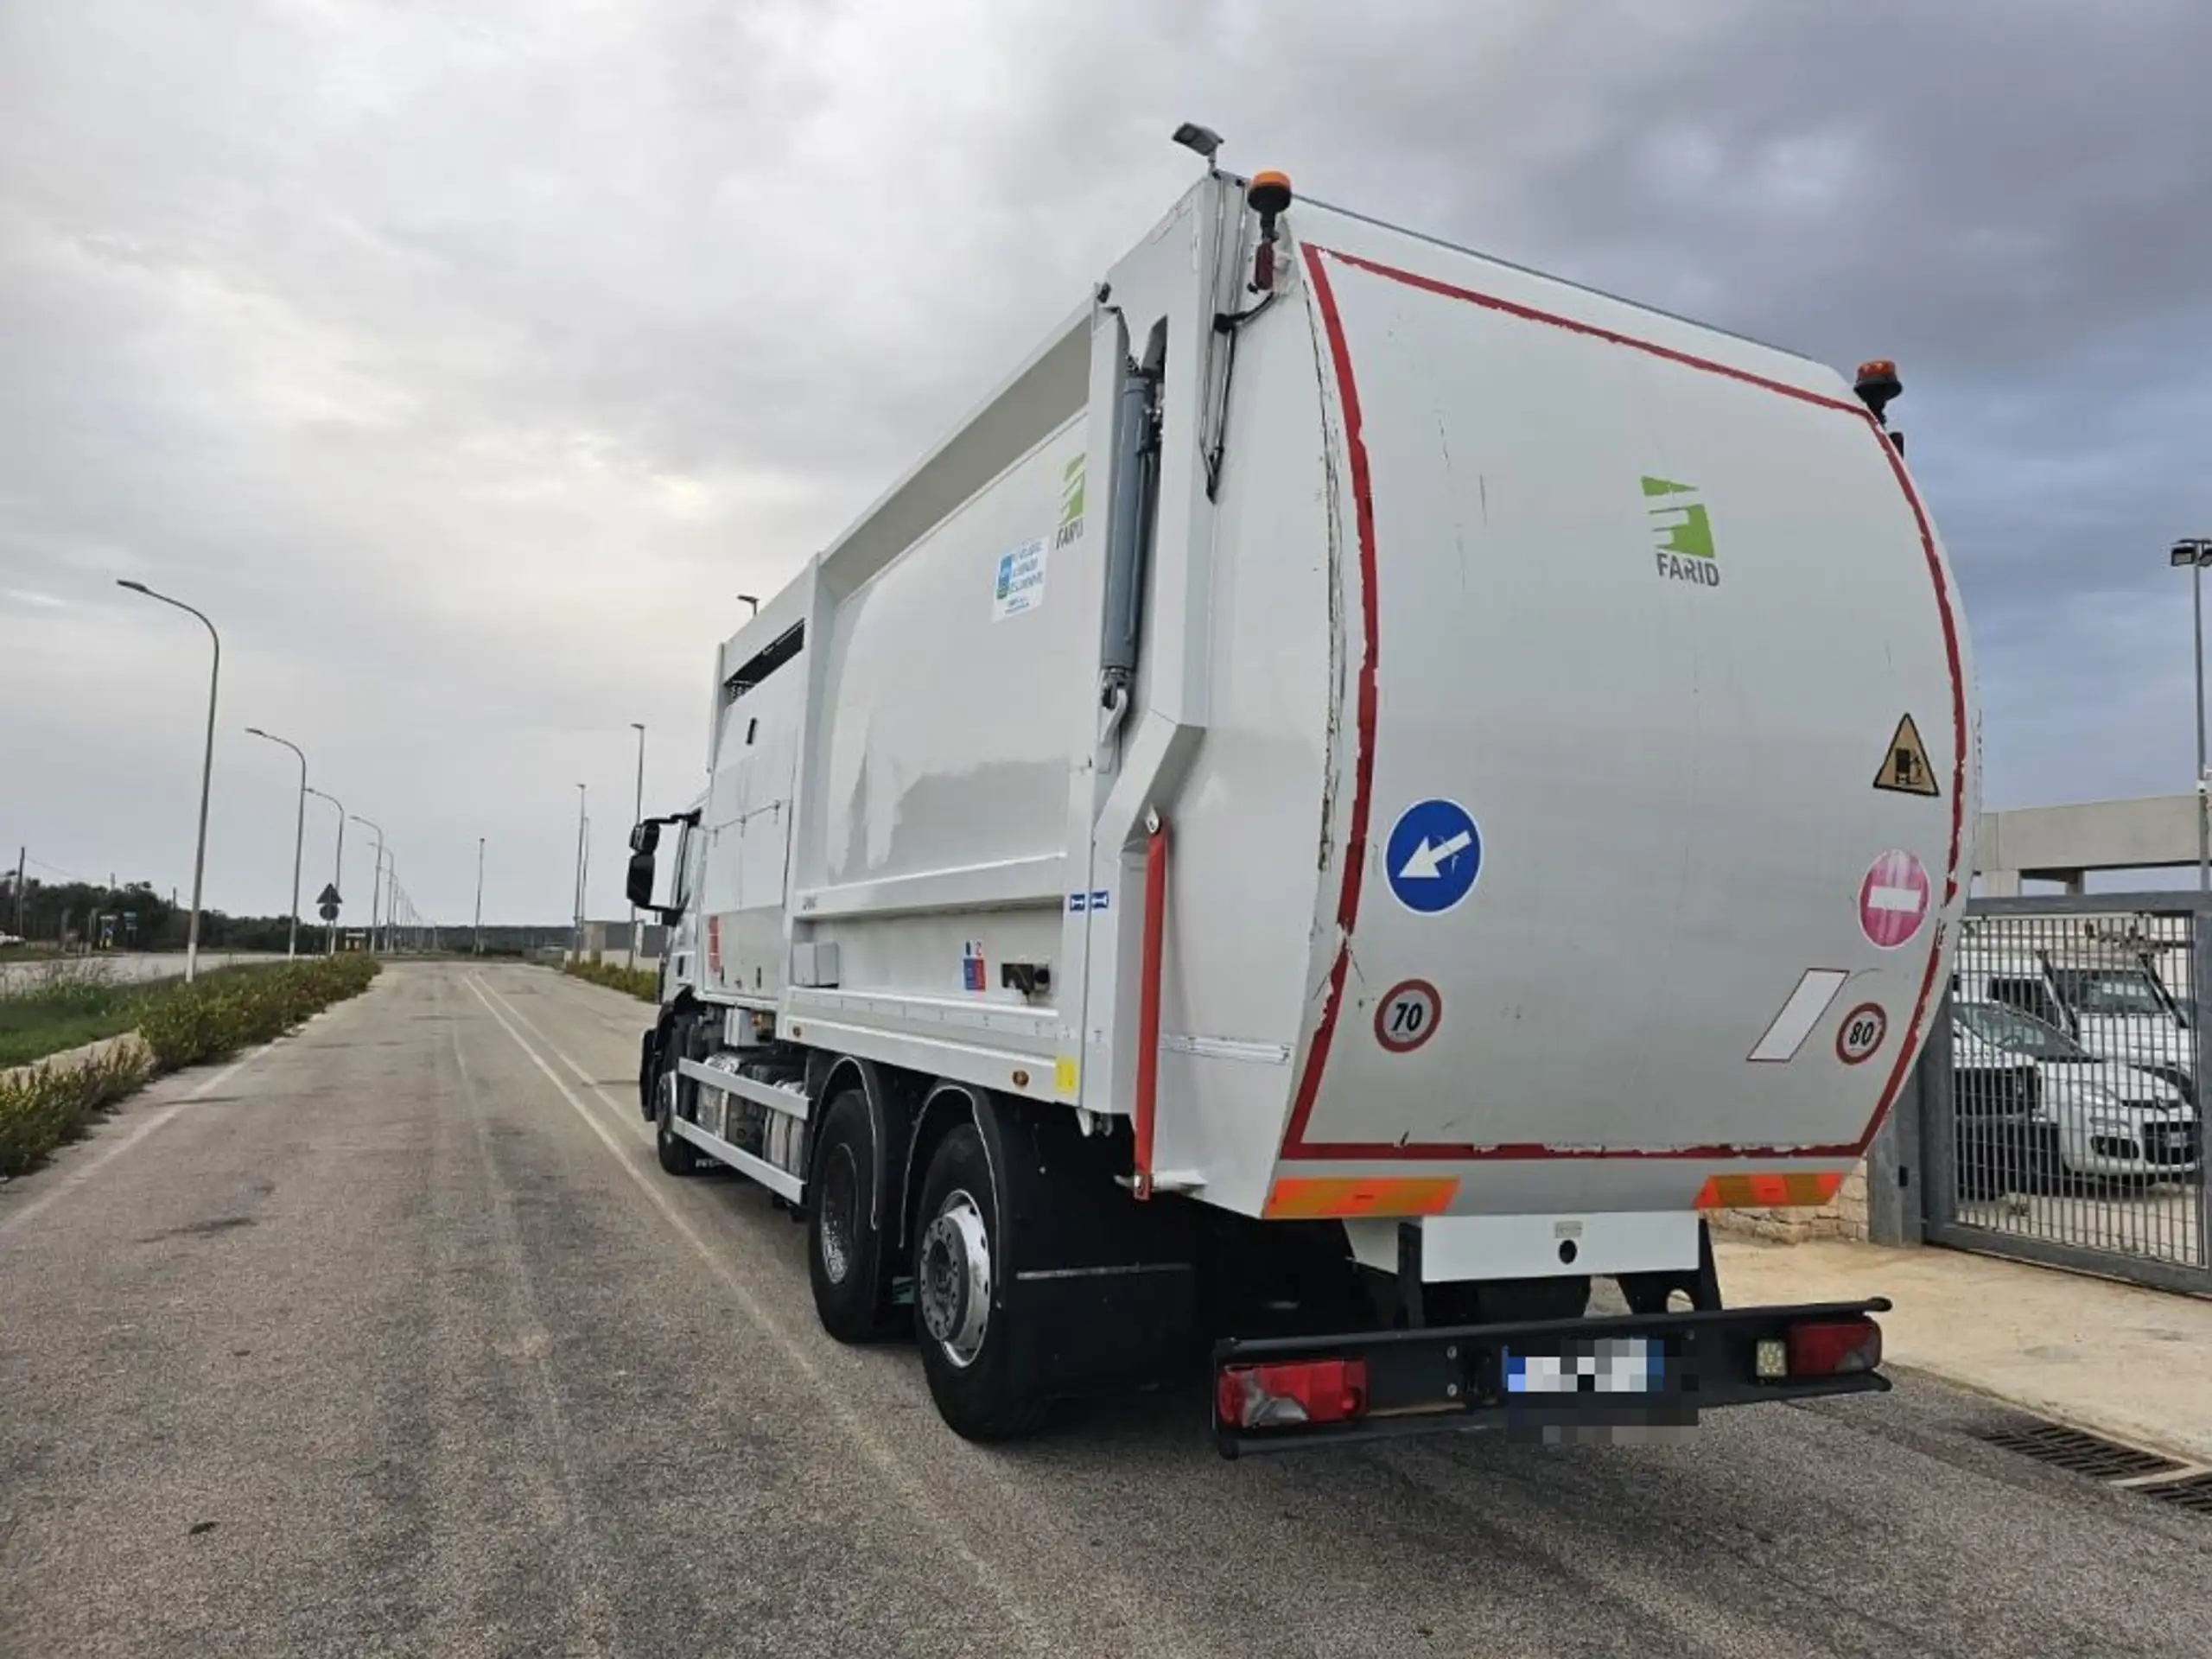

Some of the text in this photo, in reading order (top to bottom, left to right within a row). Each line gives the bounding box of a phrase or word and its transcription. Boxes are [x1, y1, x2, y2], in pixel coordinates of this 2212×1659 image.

[1656, 553, 1719, 587] FARID
[1392, 1002, 1423, 1032] 70
[1849, 1021, 1874, 1046] 80
